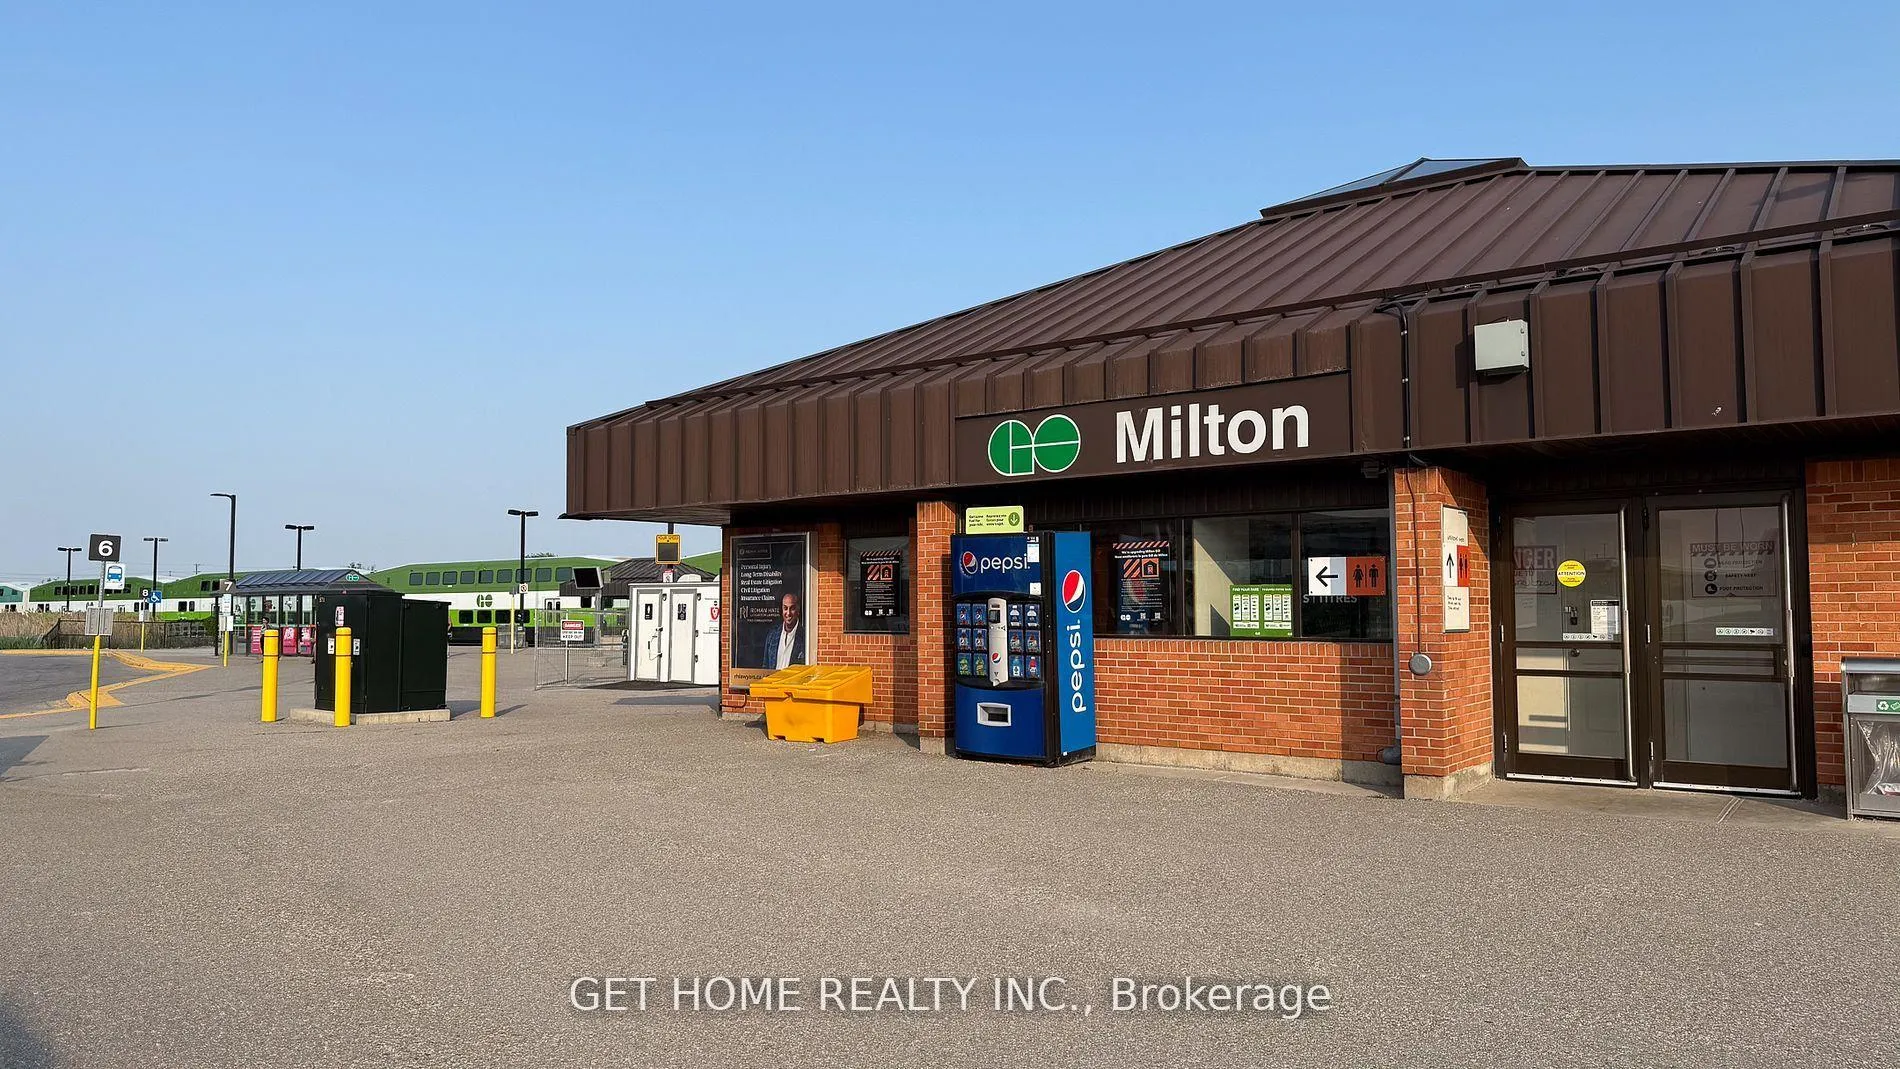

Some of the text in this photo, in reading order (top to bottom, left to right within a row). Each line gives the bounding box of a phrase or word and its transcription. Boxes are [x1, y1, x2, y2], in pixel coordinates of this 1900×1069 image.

[1116, 403, 1309, 463] Milton
[98, 540, 113, 557] 6
[224, 582, 232, 591] 7
